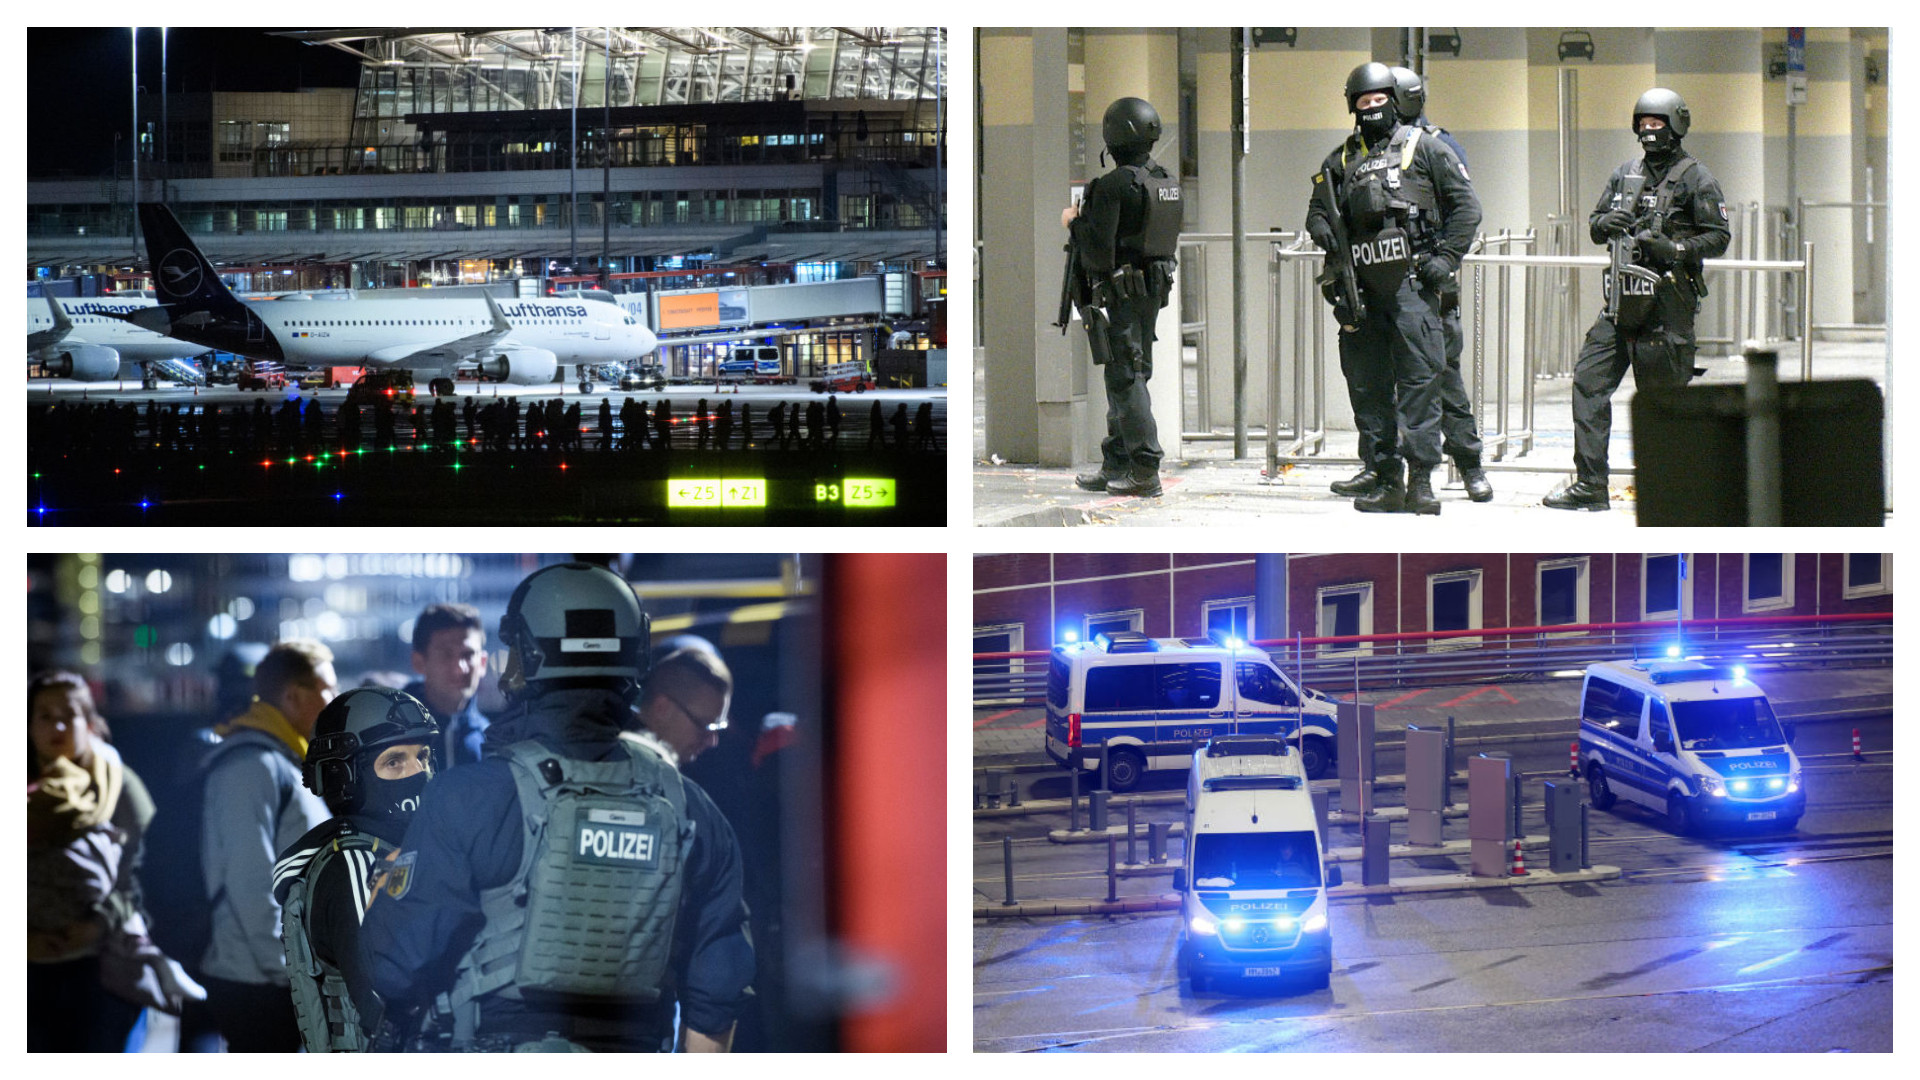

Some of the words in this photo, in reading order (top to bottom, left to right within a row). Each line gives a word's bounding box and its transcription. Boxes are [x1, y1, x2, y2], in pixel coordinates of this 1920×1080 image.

[1363, 112, 1383, 121] POLIZEI
[1158, 187, 1180, 201] POLIZEI
[1351, 237, 1407, 267] POLIZEI
[1604, 273, 1655, 298] PLIZEI
[498, 303, 588, 317] Lufthansa
[693, 486, 715, 500] Z5
[741, 486, 758, 500] Z1
[815, 484, 840, 501] B3
[851, 485, 873, 499] Z5
[1729, 760, 1778, 771] POLIZEI
[579, 828, 654, 861] POLIZEI
[1230, 902, 1288, 911] POLIZEI
